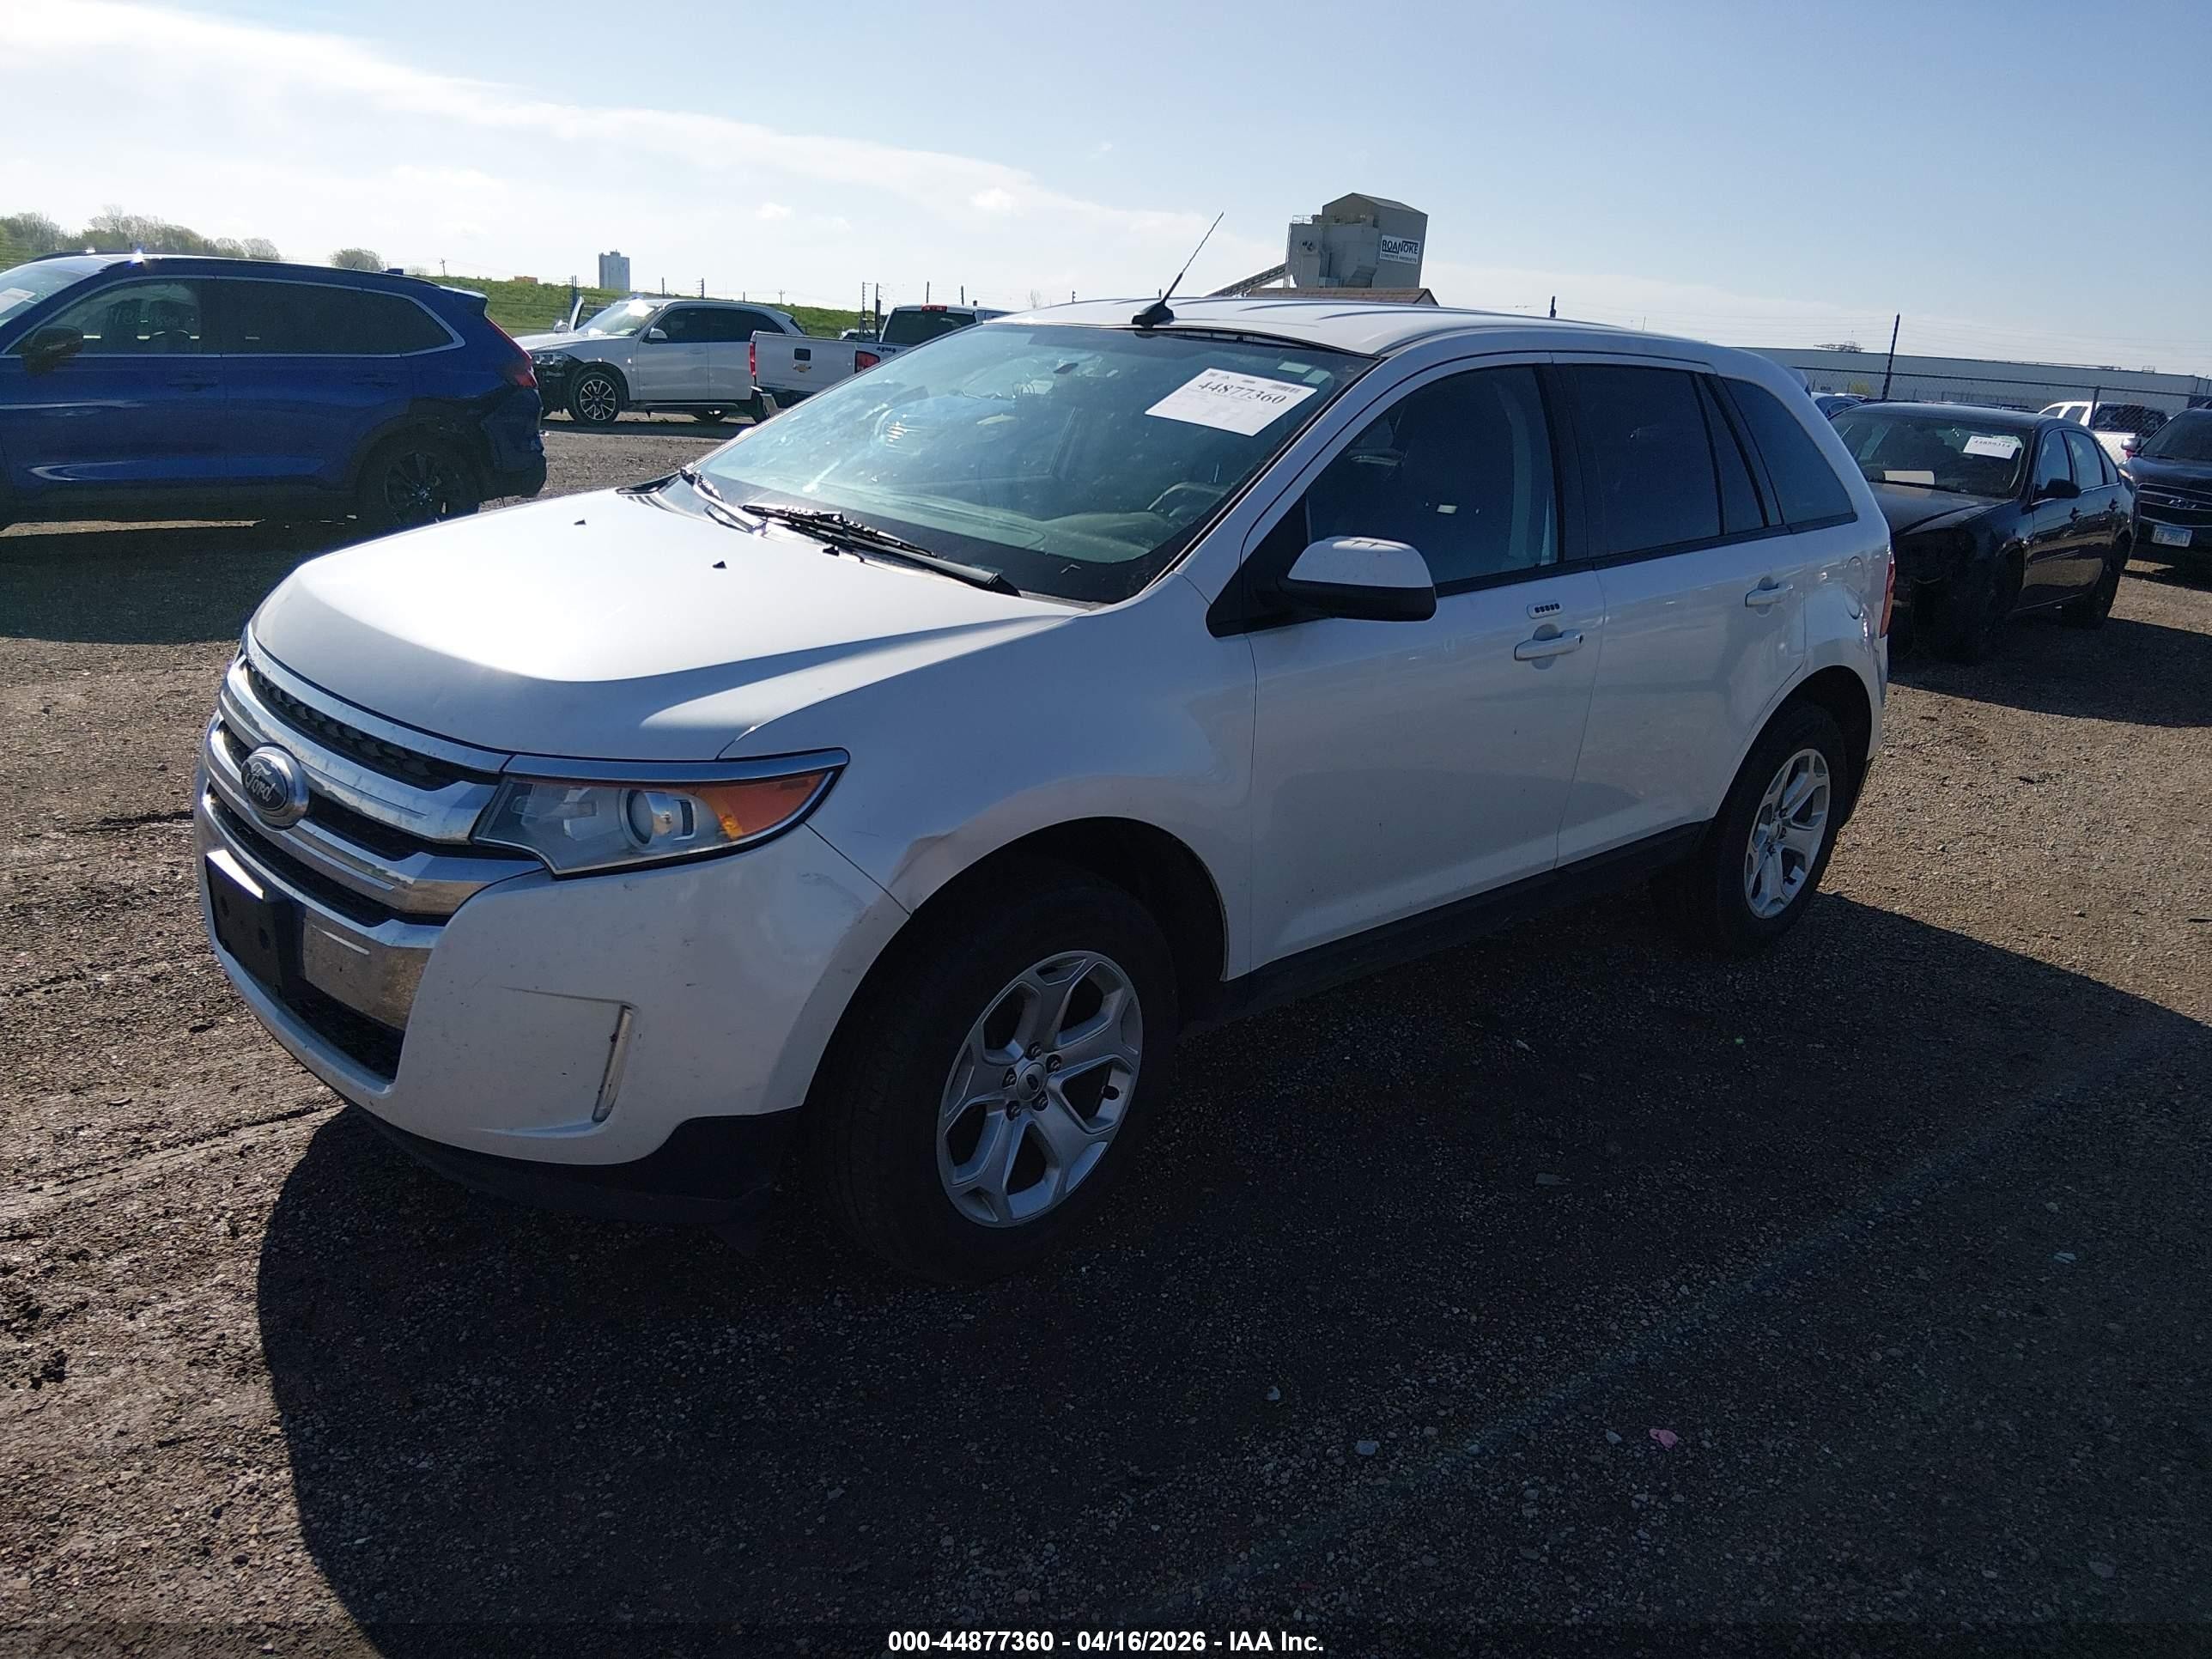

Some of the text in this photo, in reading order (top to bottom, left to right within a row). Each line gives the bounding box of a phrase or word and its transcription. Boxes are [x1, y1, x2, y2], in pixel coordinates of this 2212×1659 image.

[1382, 240, 1419, 254] ROANOKE
[1198, 380, 1287, 404] 44877360
[245, 762, 276, 802] Ford
